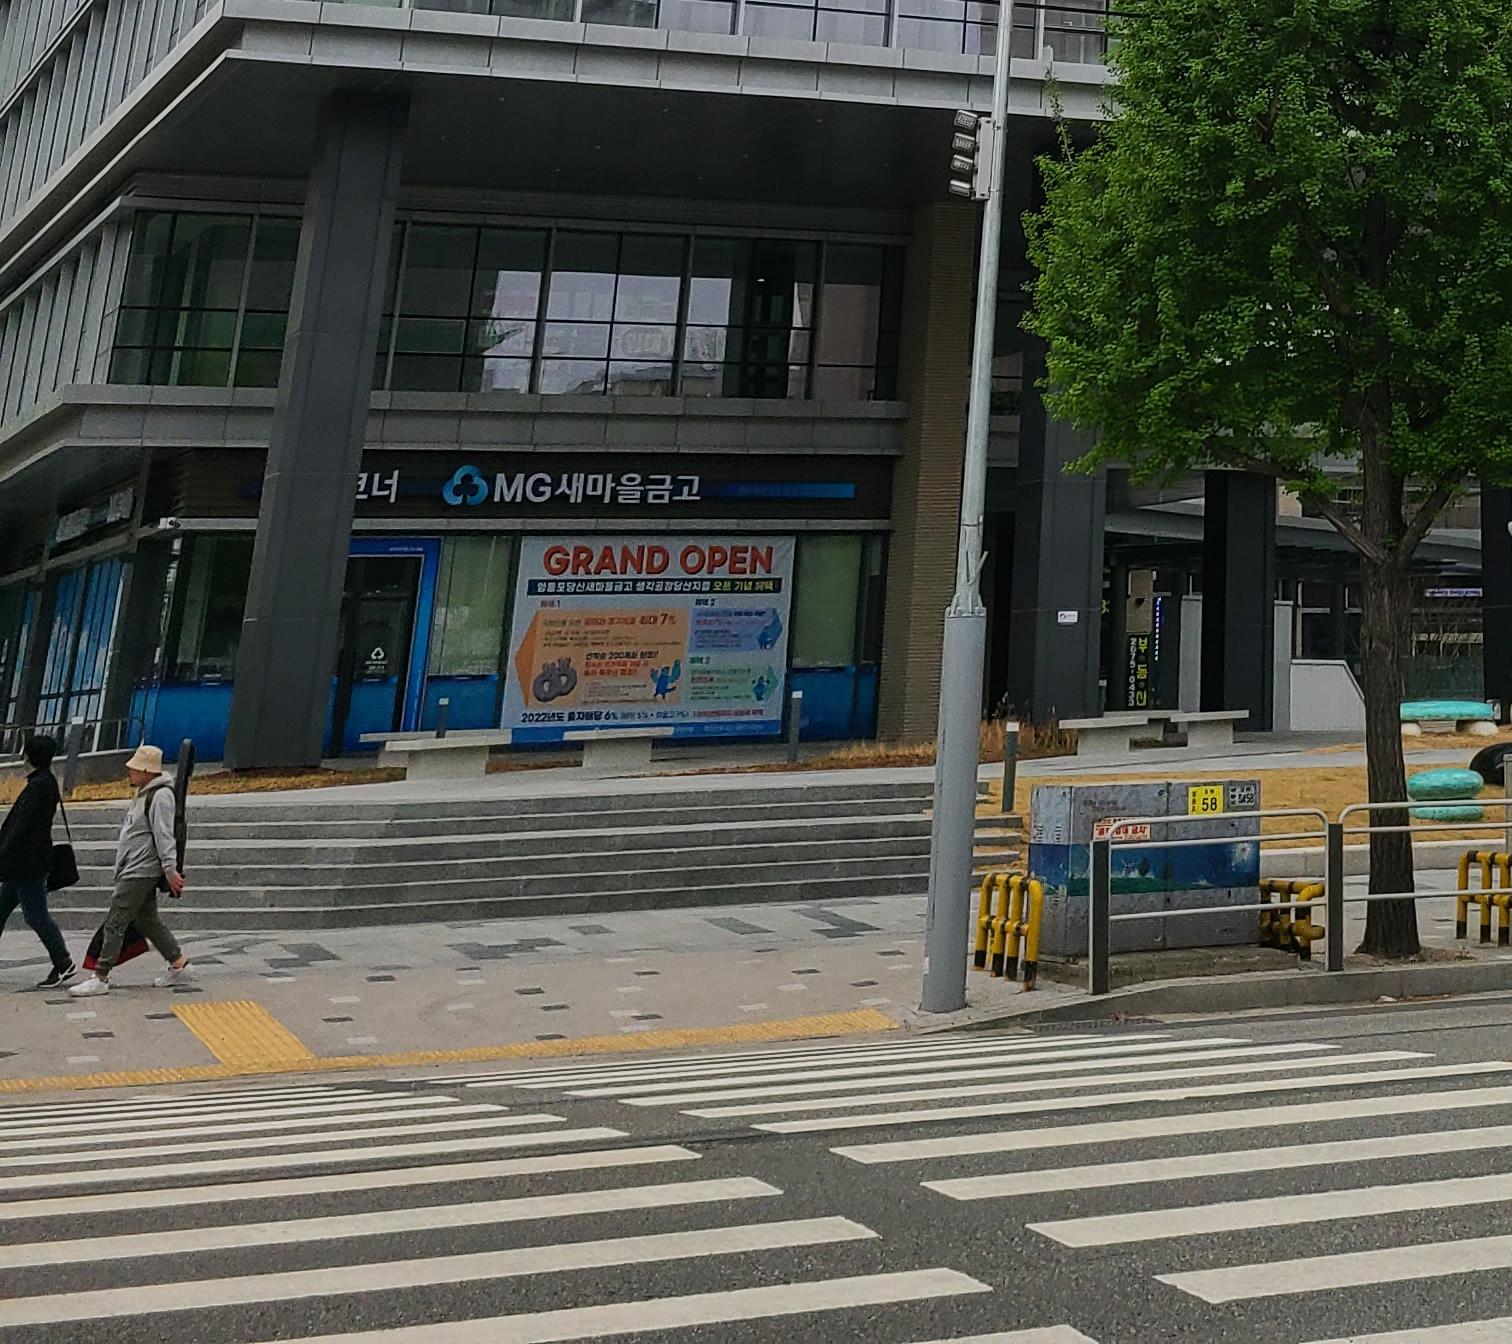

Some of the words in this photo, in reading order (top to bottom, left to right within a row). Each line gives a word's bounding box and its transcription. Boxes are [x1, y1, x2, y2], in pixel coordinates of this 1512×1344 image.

[543, 545, 669, 575] GRAND
[680, 544, 773, 575] OPEN
[1202, 797, 1218, 811] 58
